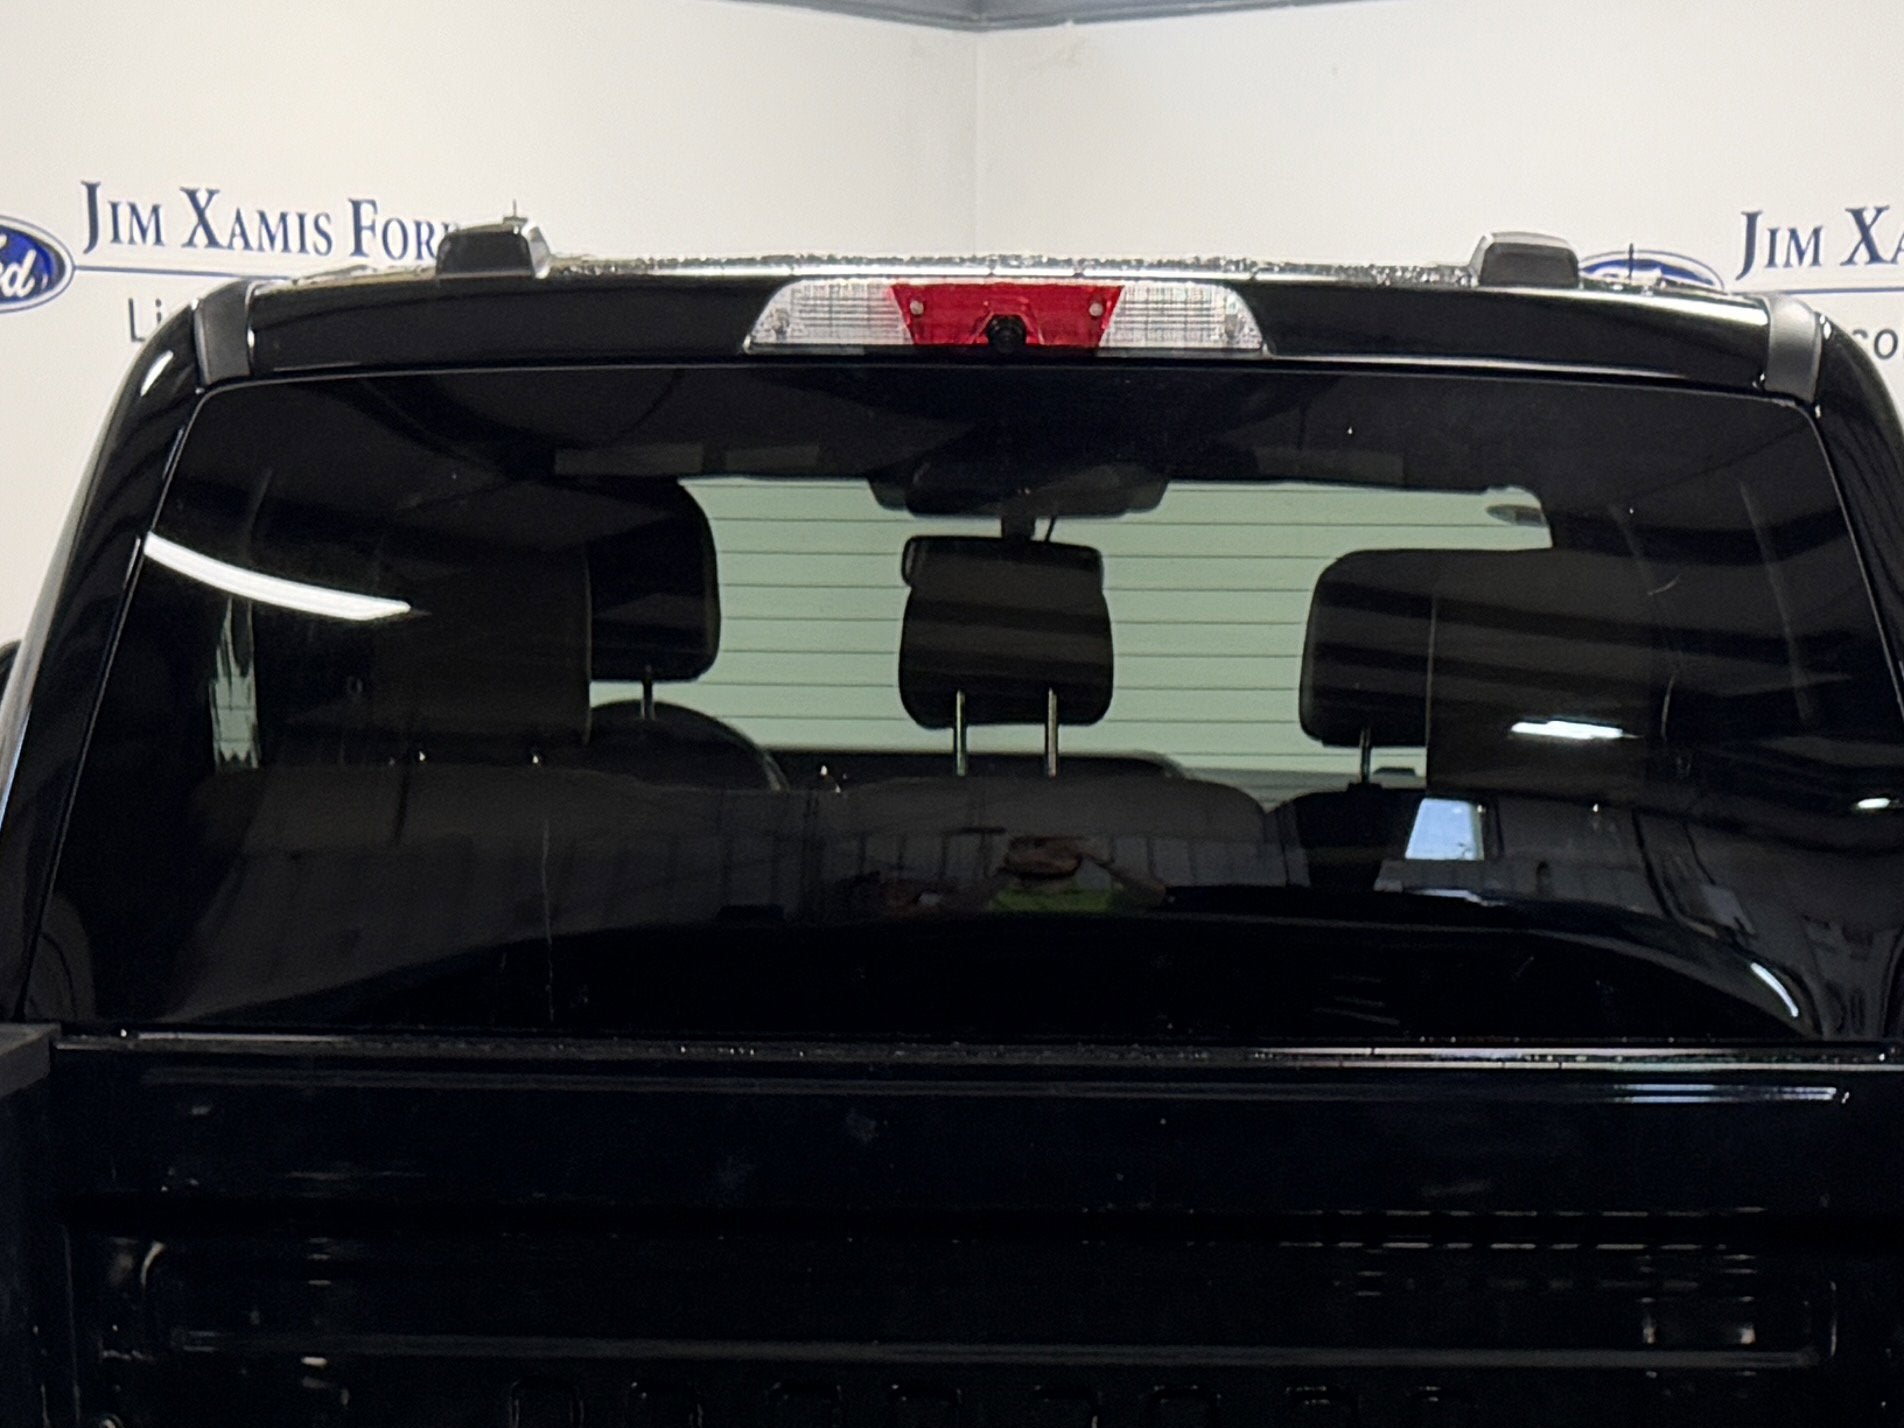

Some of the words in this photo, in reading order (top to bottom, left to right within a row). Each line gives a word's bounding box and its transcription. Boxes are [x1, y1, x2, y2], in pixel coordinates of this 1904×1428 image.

[81, 181, 166, 254] JIM
[180, 186, 333, 257] XAMIS
[1735, 209, 1824, 281] JIM
